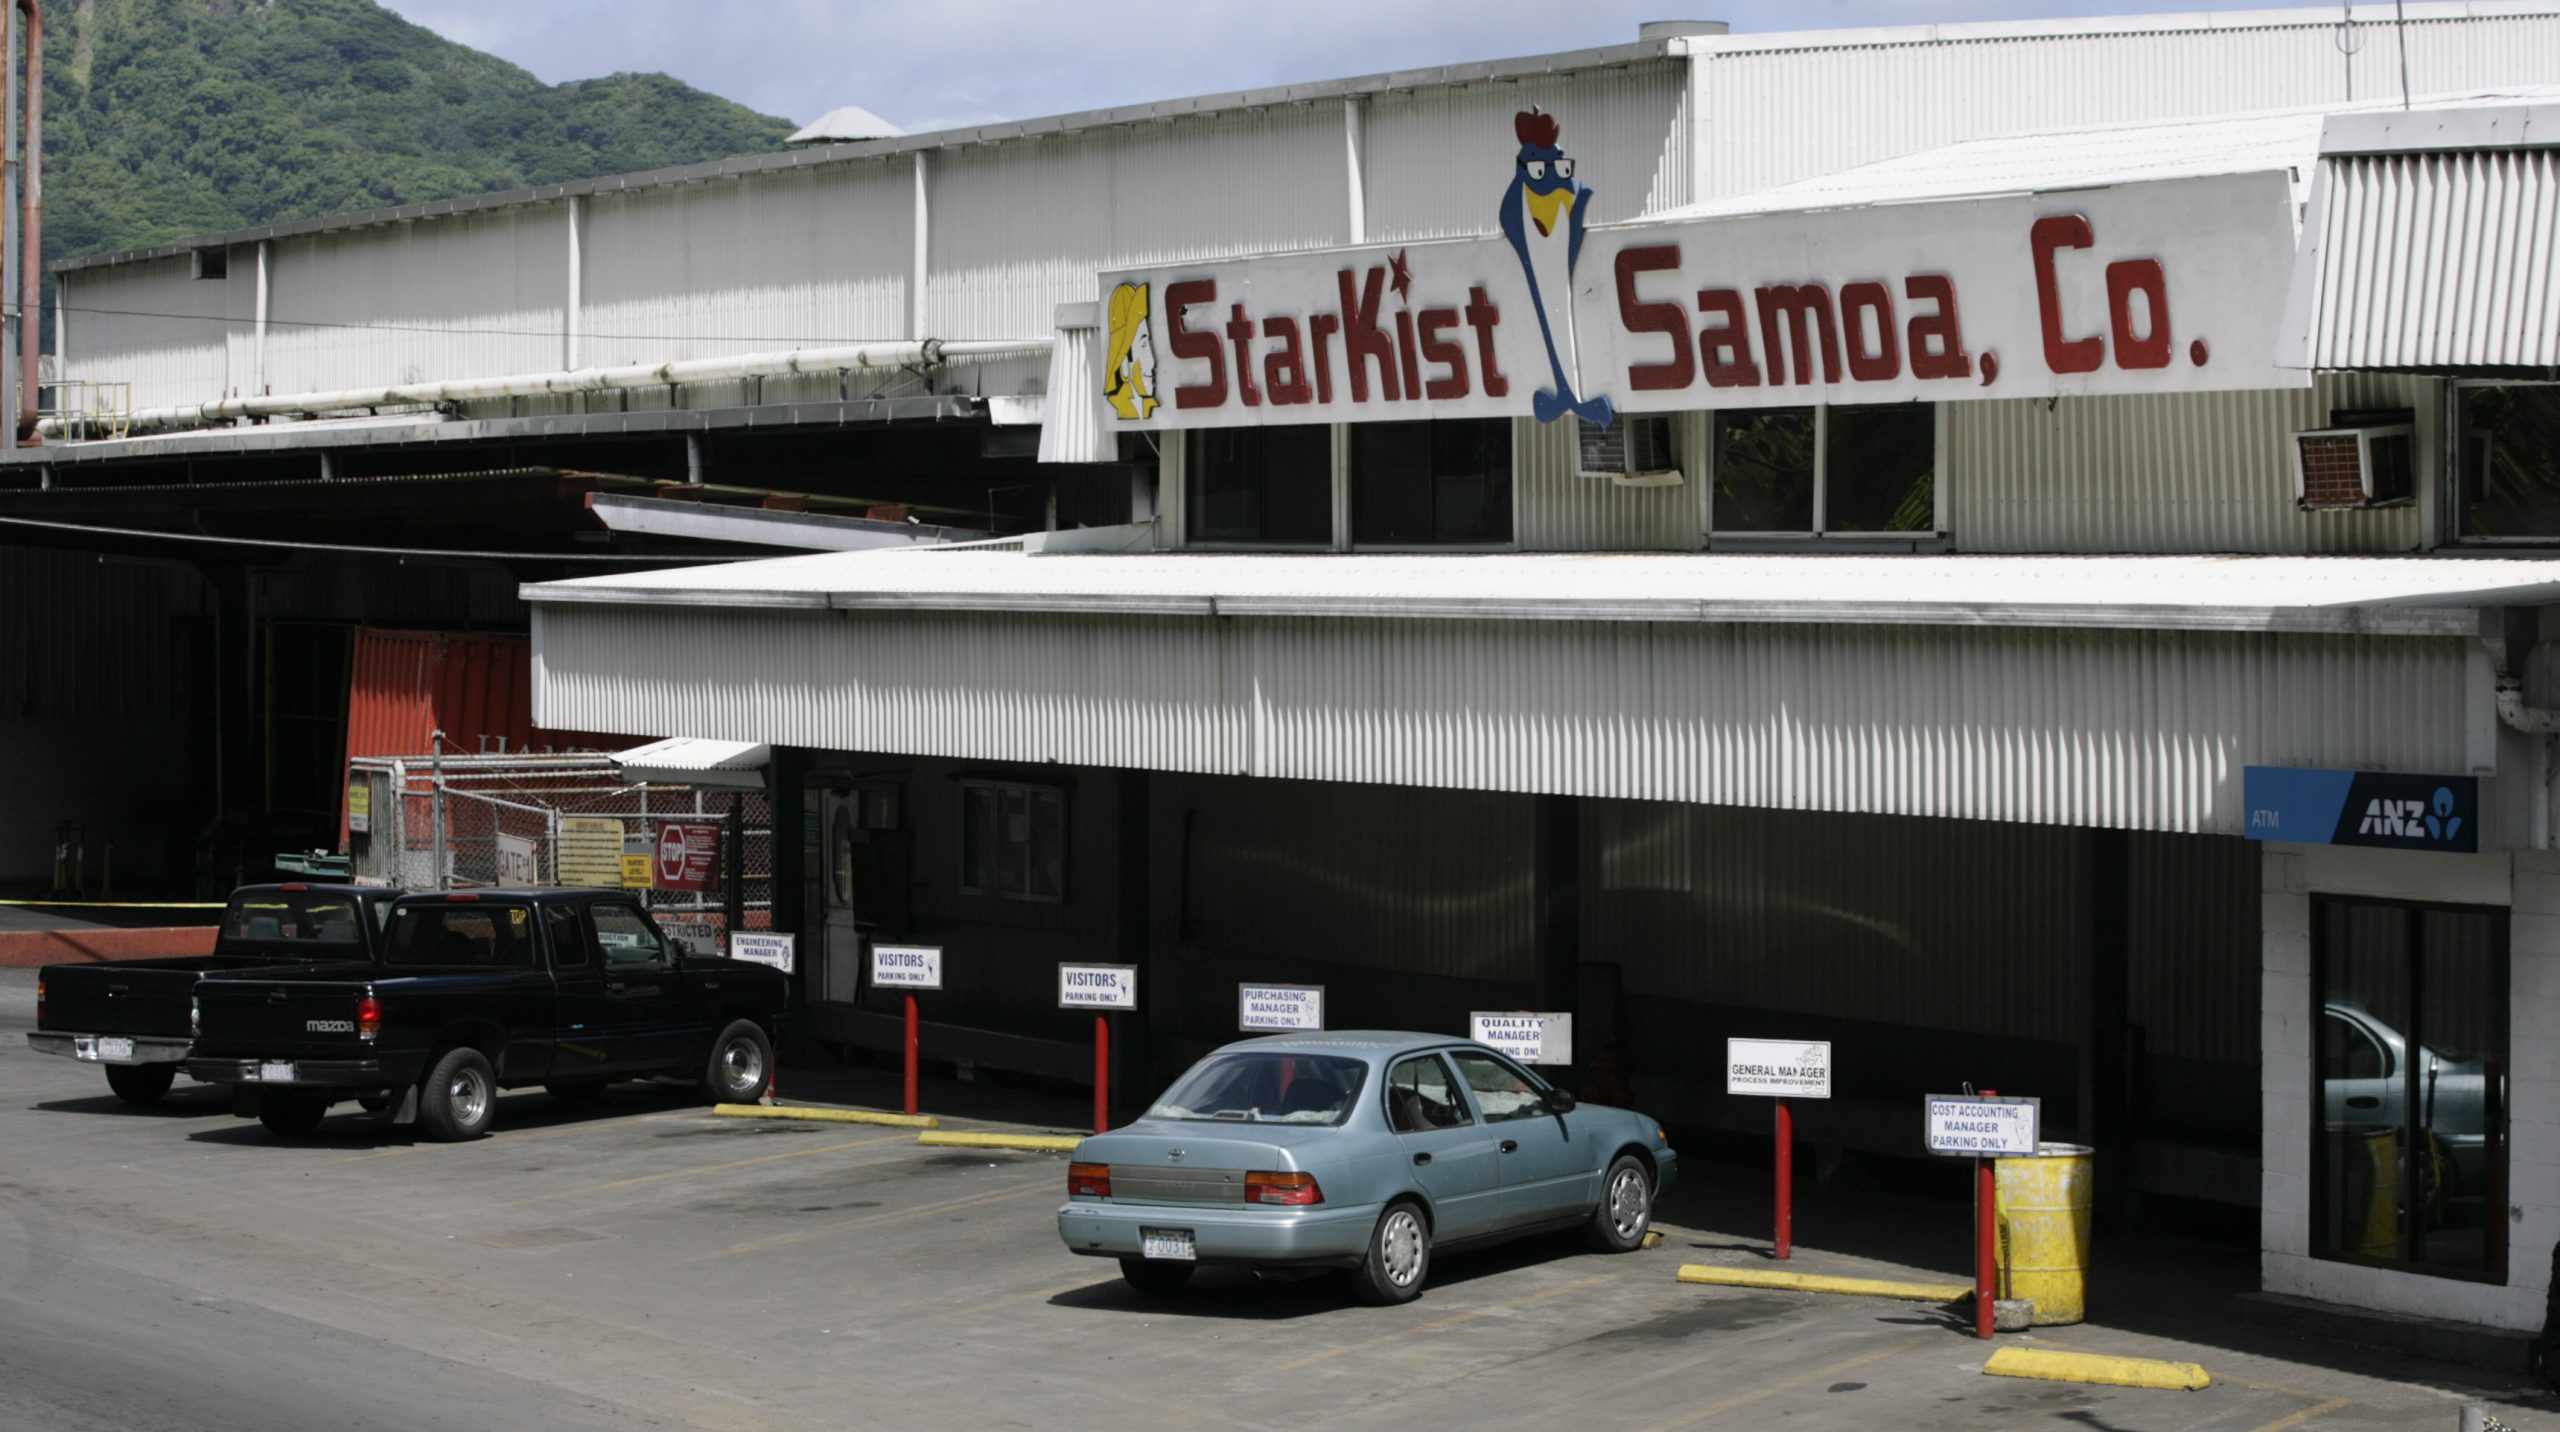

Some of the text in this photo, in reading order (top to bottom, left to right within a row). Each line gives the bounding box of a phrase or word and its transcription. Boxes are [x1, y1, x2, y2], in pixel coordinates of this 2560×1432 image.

[1164, 213, 2210, 410] StarKist Samoa, Co.
[2251, 809, 2280, 829] ATM
[2358, 798, 2426, 838] ANZ
[661, 923, 712, 938] ESTRICTED
[736, 937, 783, 948] ENGINEERING
[743, 947, 778, 957] MANAGER
[878, 953, 924, 968] VISITORS
[877, 971, 925, 982] PARKING ONLY
[1066, 971, 1117, 987] VISITORS
[1065, 991, 1118, 1002] PARKING ONLY
[1244, 990, 1306, 1001] PURCHASING
[1250, 1003, 1299, 1014] MANAGER
[1244, 1015, 1301, 1026] PARKING ONLY
[1482, 1018, 1545, 1028] QUALITY
[1487, 1030, 1540, 1041] MANAGER
[1732, 1064, 1826, 1078] GENERAL MANAGER
[1769, 1078, 1826, 1086] IMPROVEMENT
[1932, 1104, 2019, 1119] COST ACCOUNTING
[1944, 1121, 1999, 1133] MANAGER
[1932, 1136, 2008, 1149] PARKING ONLY
